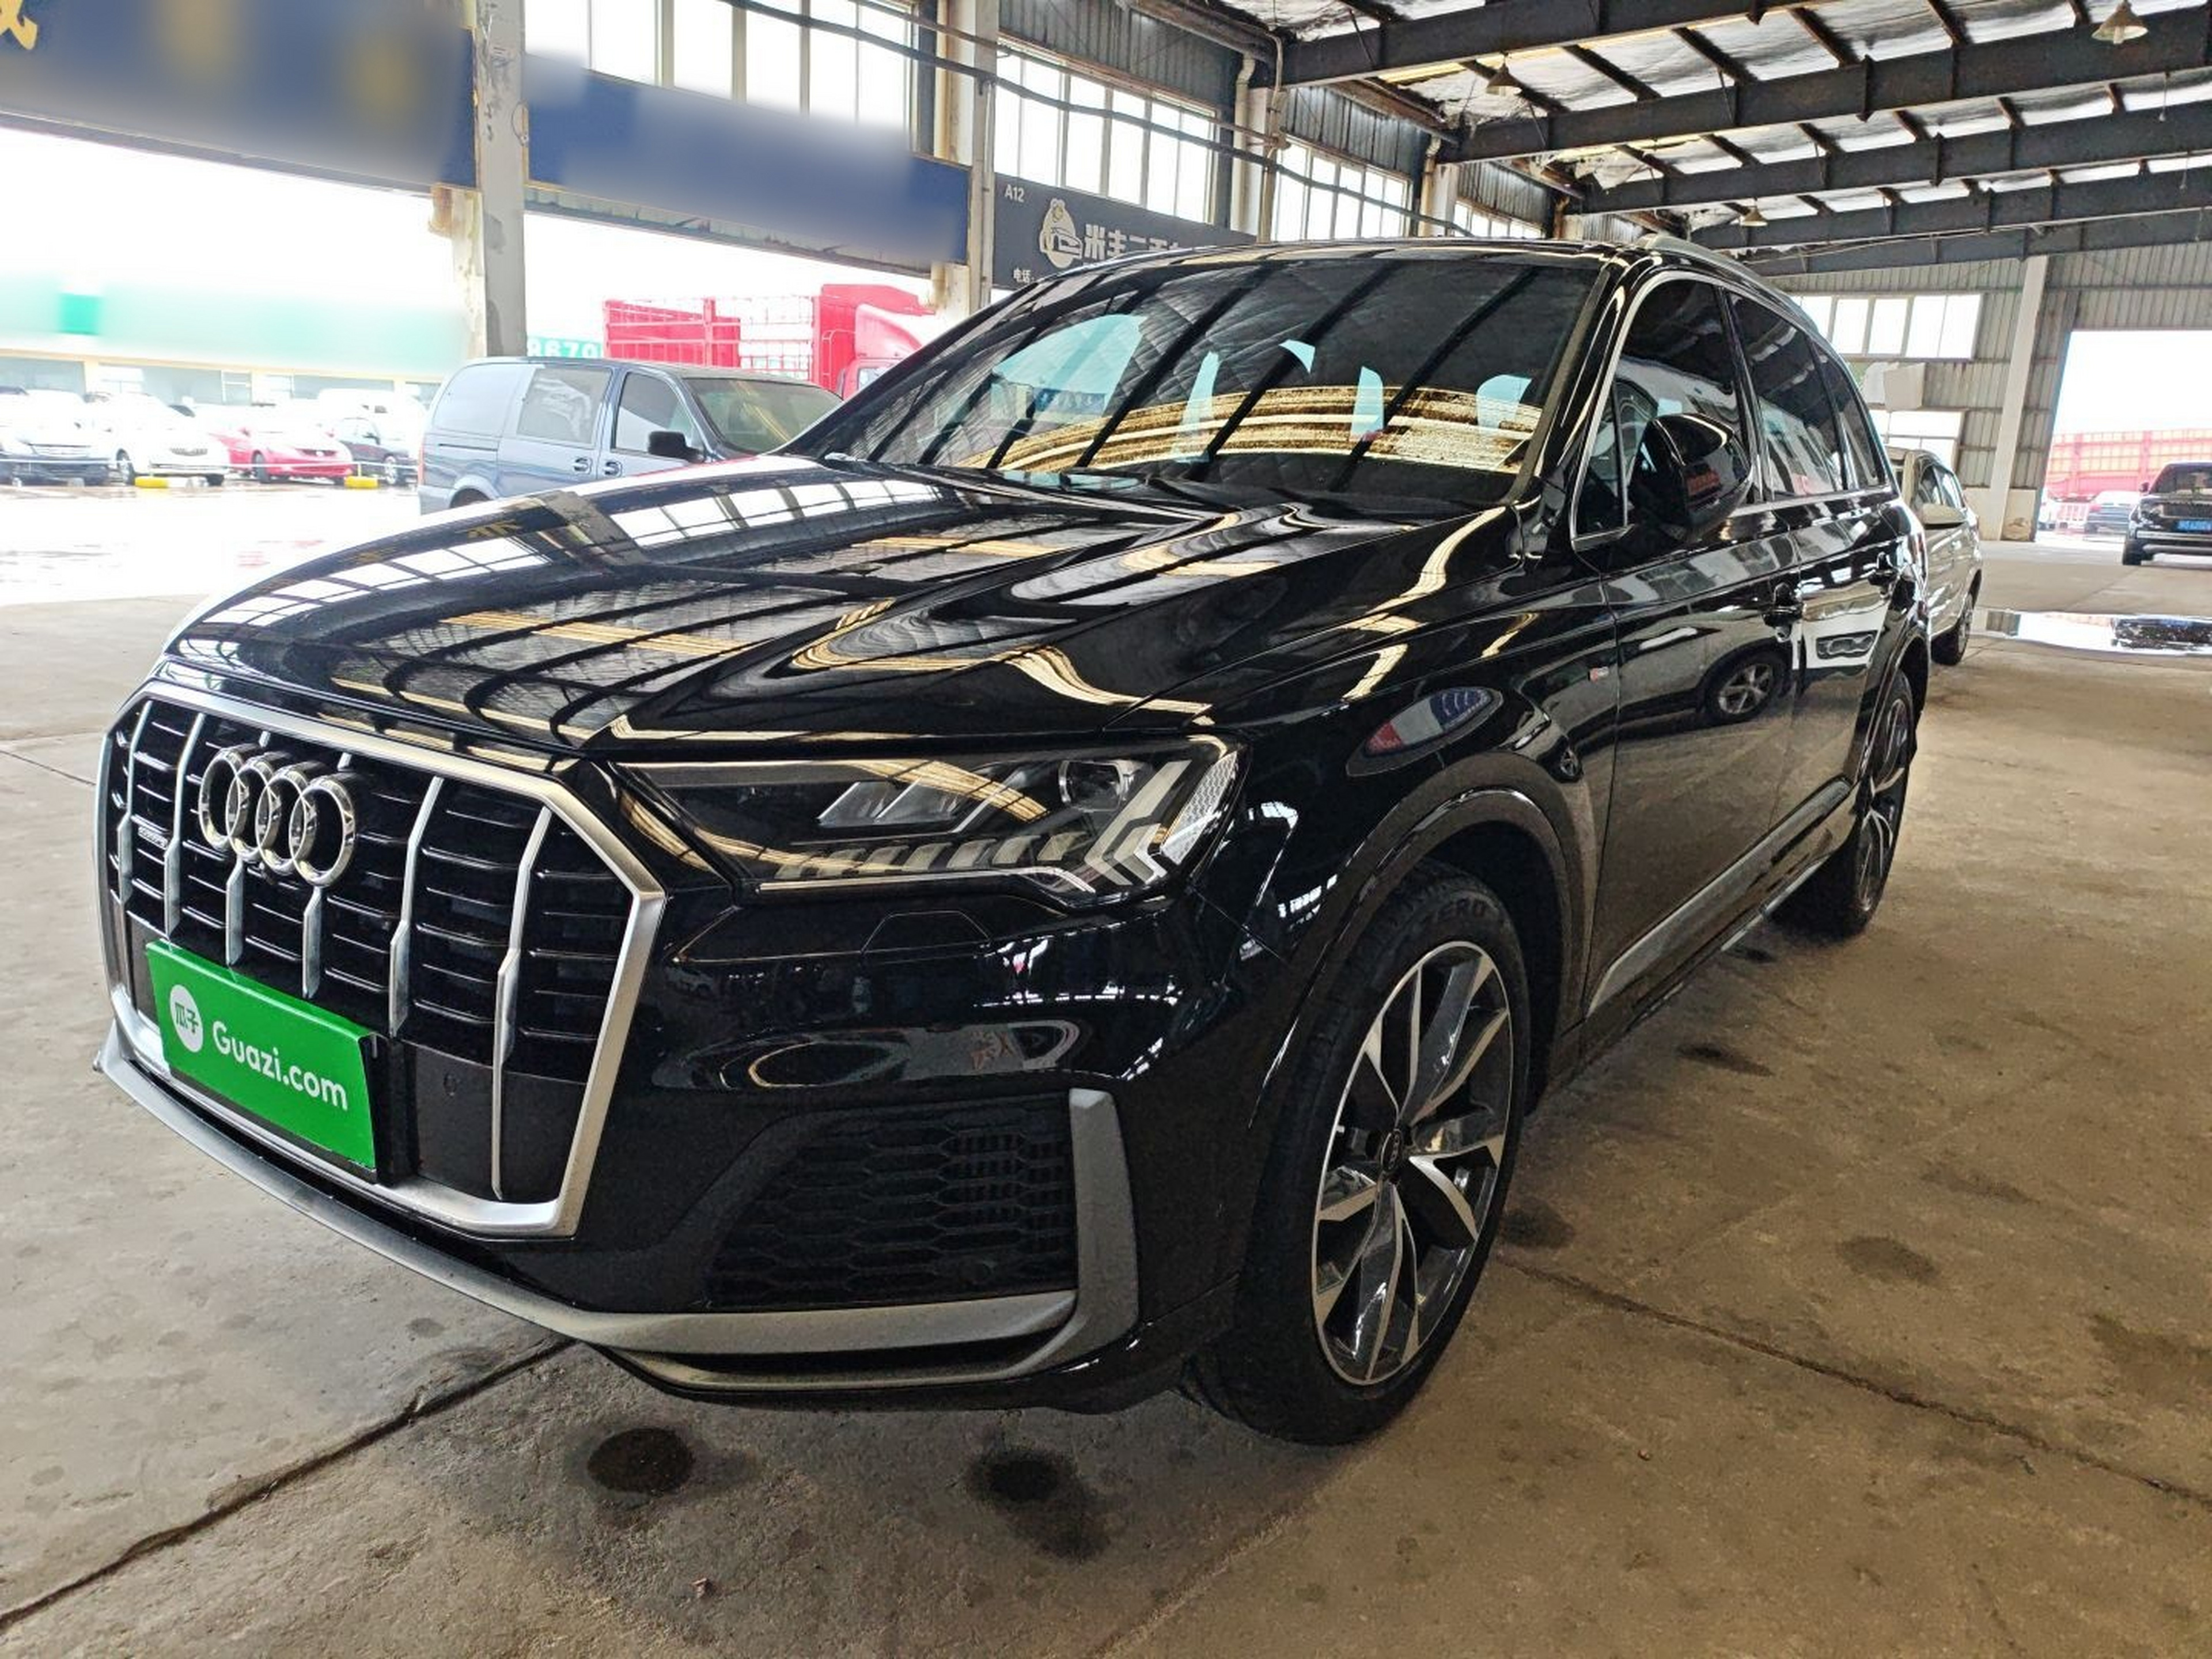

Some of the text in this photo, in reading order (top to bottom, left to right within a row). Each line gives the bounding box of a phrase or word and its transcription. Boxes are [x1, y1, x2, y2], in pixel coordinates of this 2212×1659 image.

[1005, 184, 1025, 202] A12
[175, 1002, 199, 1035] 瓜子
[213, 1021, 347, 1111] Guazi.com
